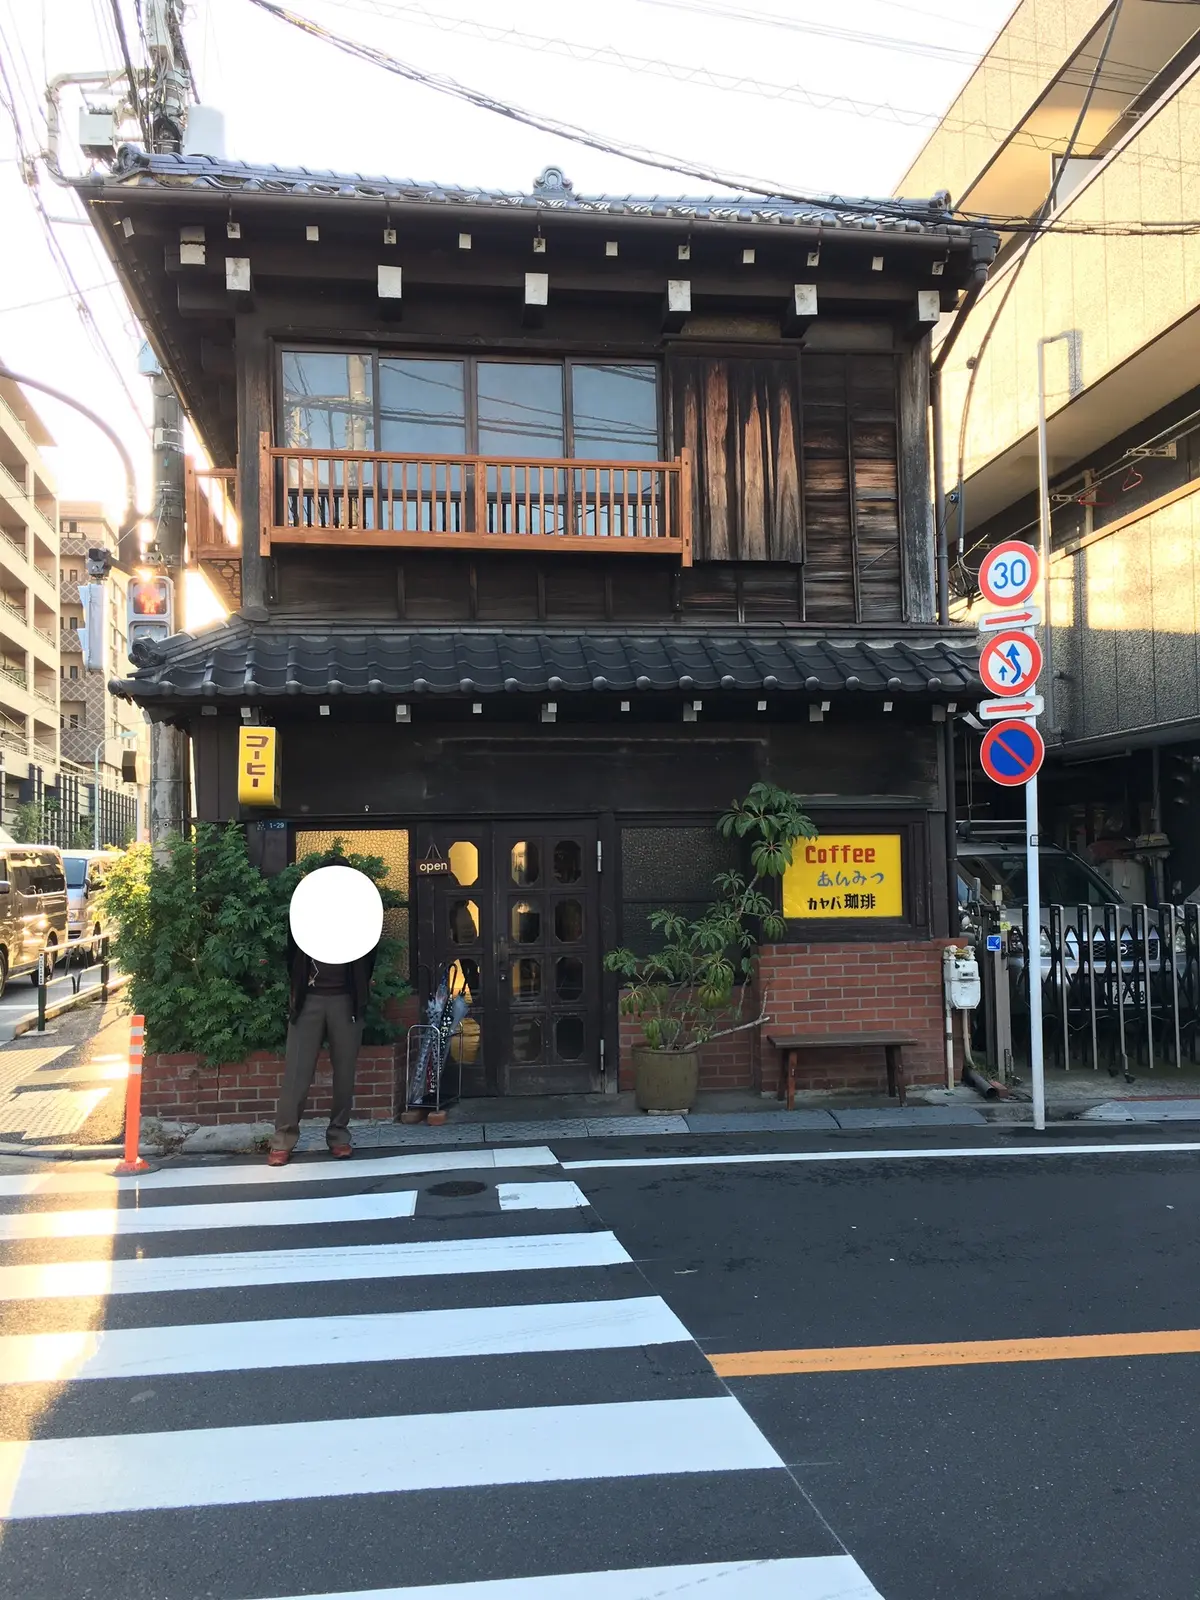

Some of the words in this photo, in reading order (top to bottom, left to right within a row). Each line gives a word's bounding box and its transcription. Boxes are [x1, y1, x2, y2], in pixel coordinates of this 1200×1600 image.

[994, 559, 1026, 589] 30
[246, 735, 269, 787] コーヒー
[805, 845, 875, 864] Coffee
[420, 862, 448, 874] open
[817, 870, 885, 887] あんみつ
[807, 893, 876, 910] カヤバ珈琲
